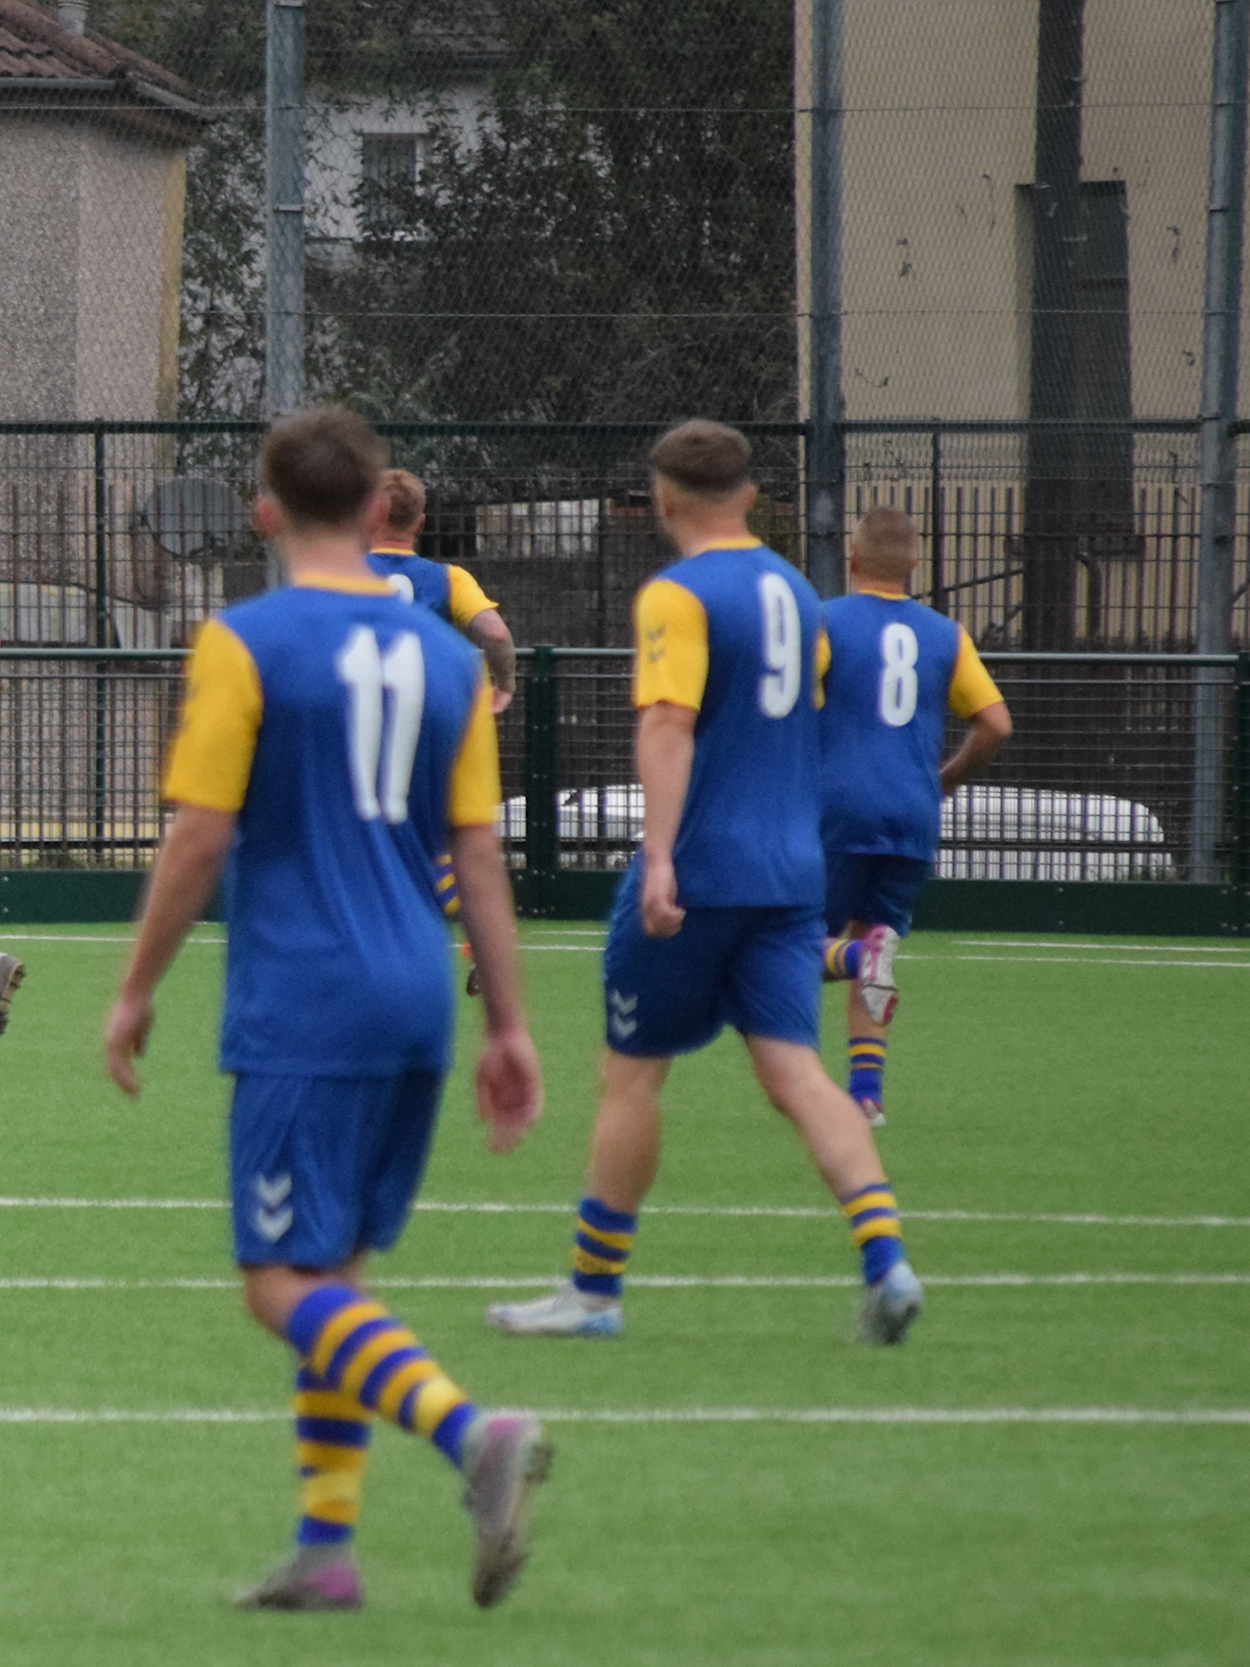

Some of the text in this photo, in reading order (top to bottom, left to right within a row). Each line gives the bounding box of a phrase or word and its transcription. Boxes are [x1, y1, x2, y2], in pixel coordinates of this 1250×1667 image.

[760, 572, 800, 719] 9
[880, 622, 918, 727] 8
[338, 624, 425, 824] 11
